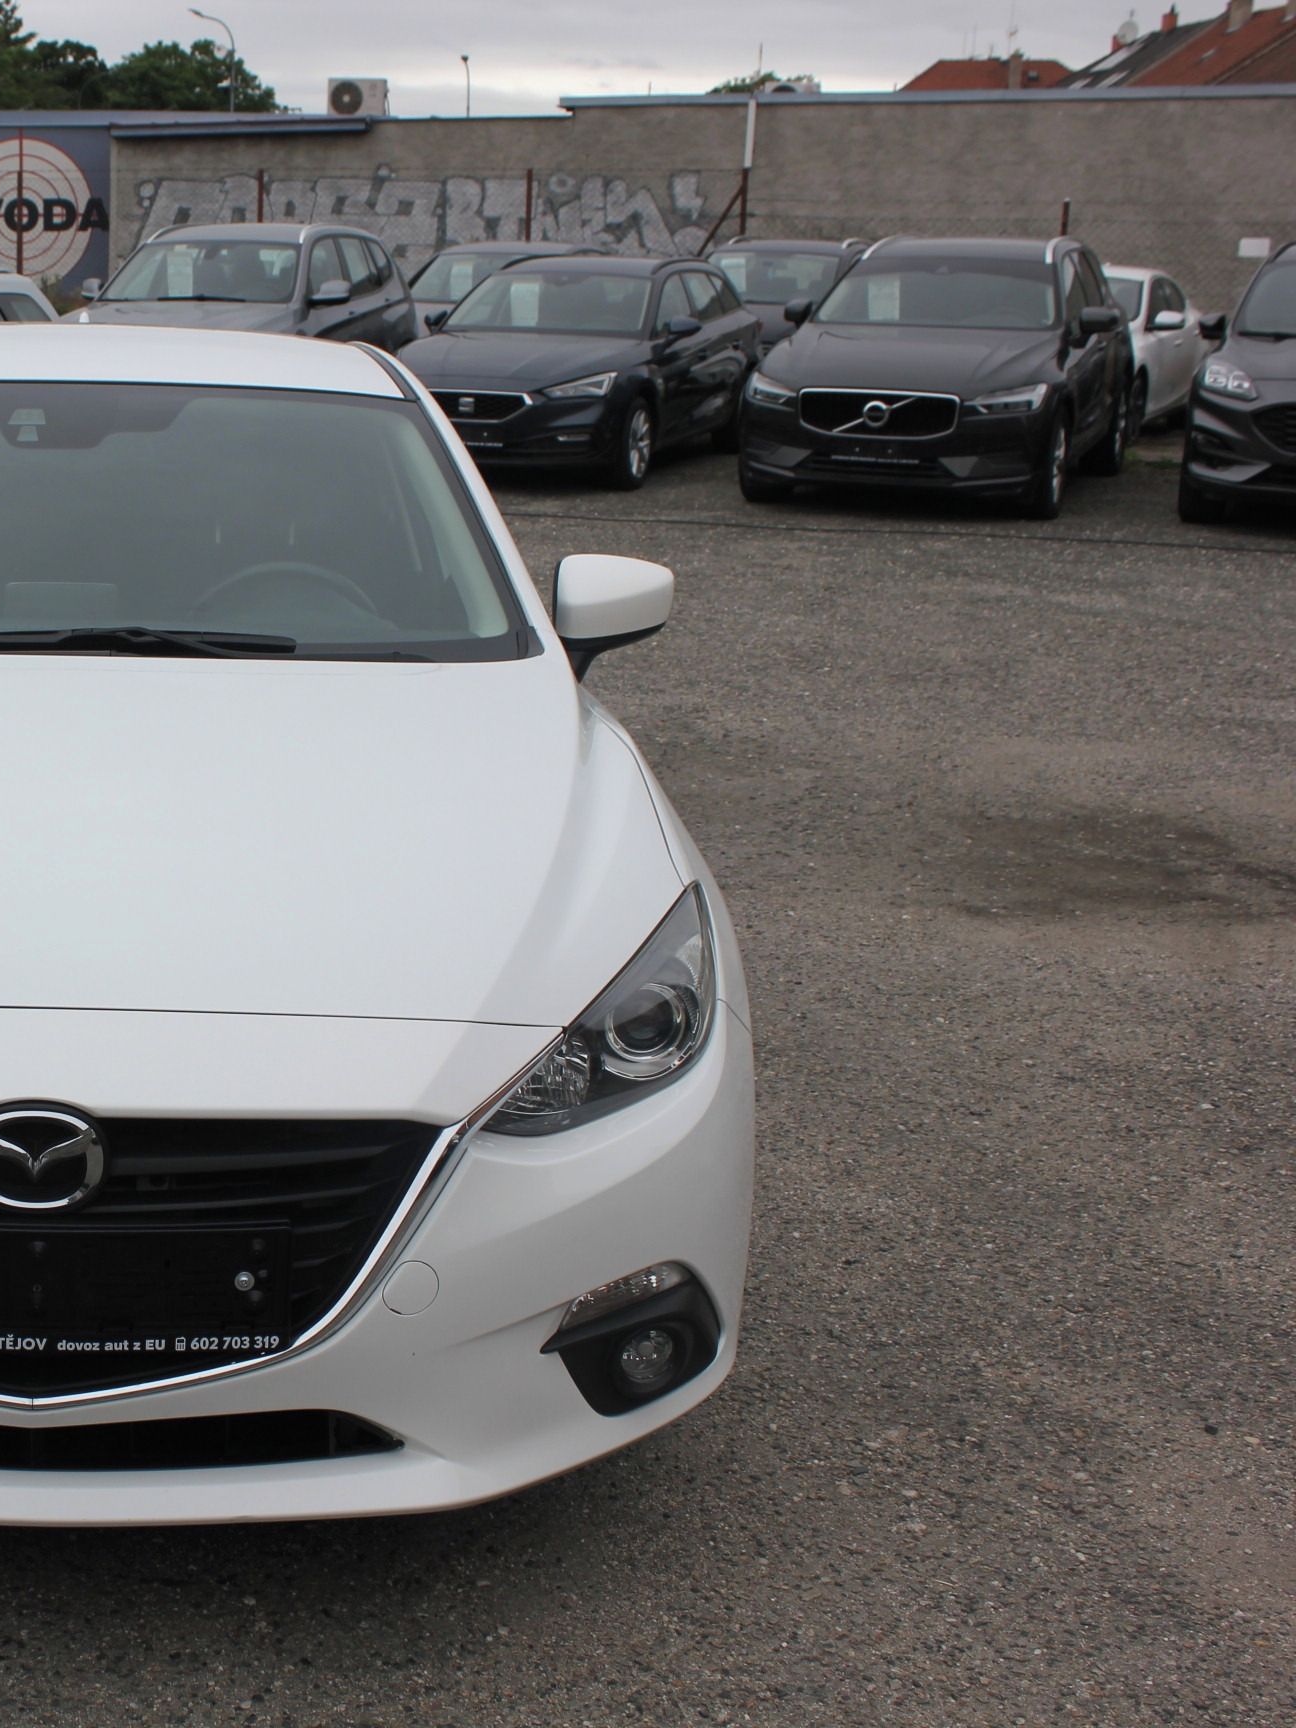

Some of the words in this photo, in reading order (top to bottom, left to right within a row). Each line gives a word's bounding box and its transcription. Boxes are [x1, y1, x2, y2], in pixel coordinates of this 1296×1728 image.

[57, 1339, 100, 1351] dovoz
[104, 1340, 129, 1351] aut
[133, 1342, 141, 1351] z
[145, 1339, 166, 1351] EU
[190, 1337, 219, 1350] 602
[222, 1336, 250, 1349] 703
[253, 1335, 280, 1348] 319
